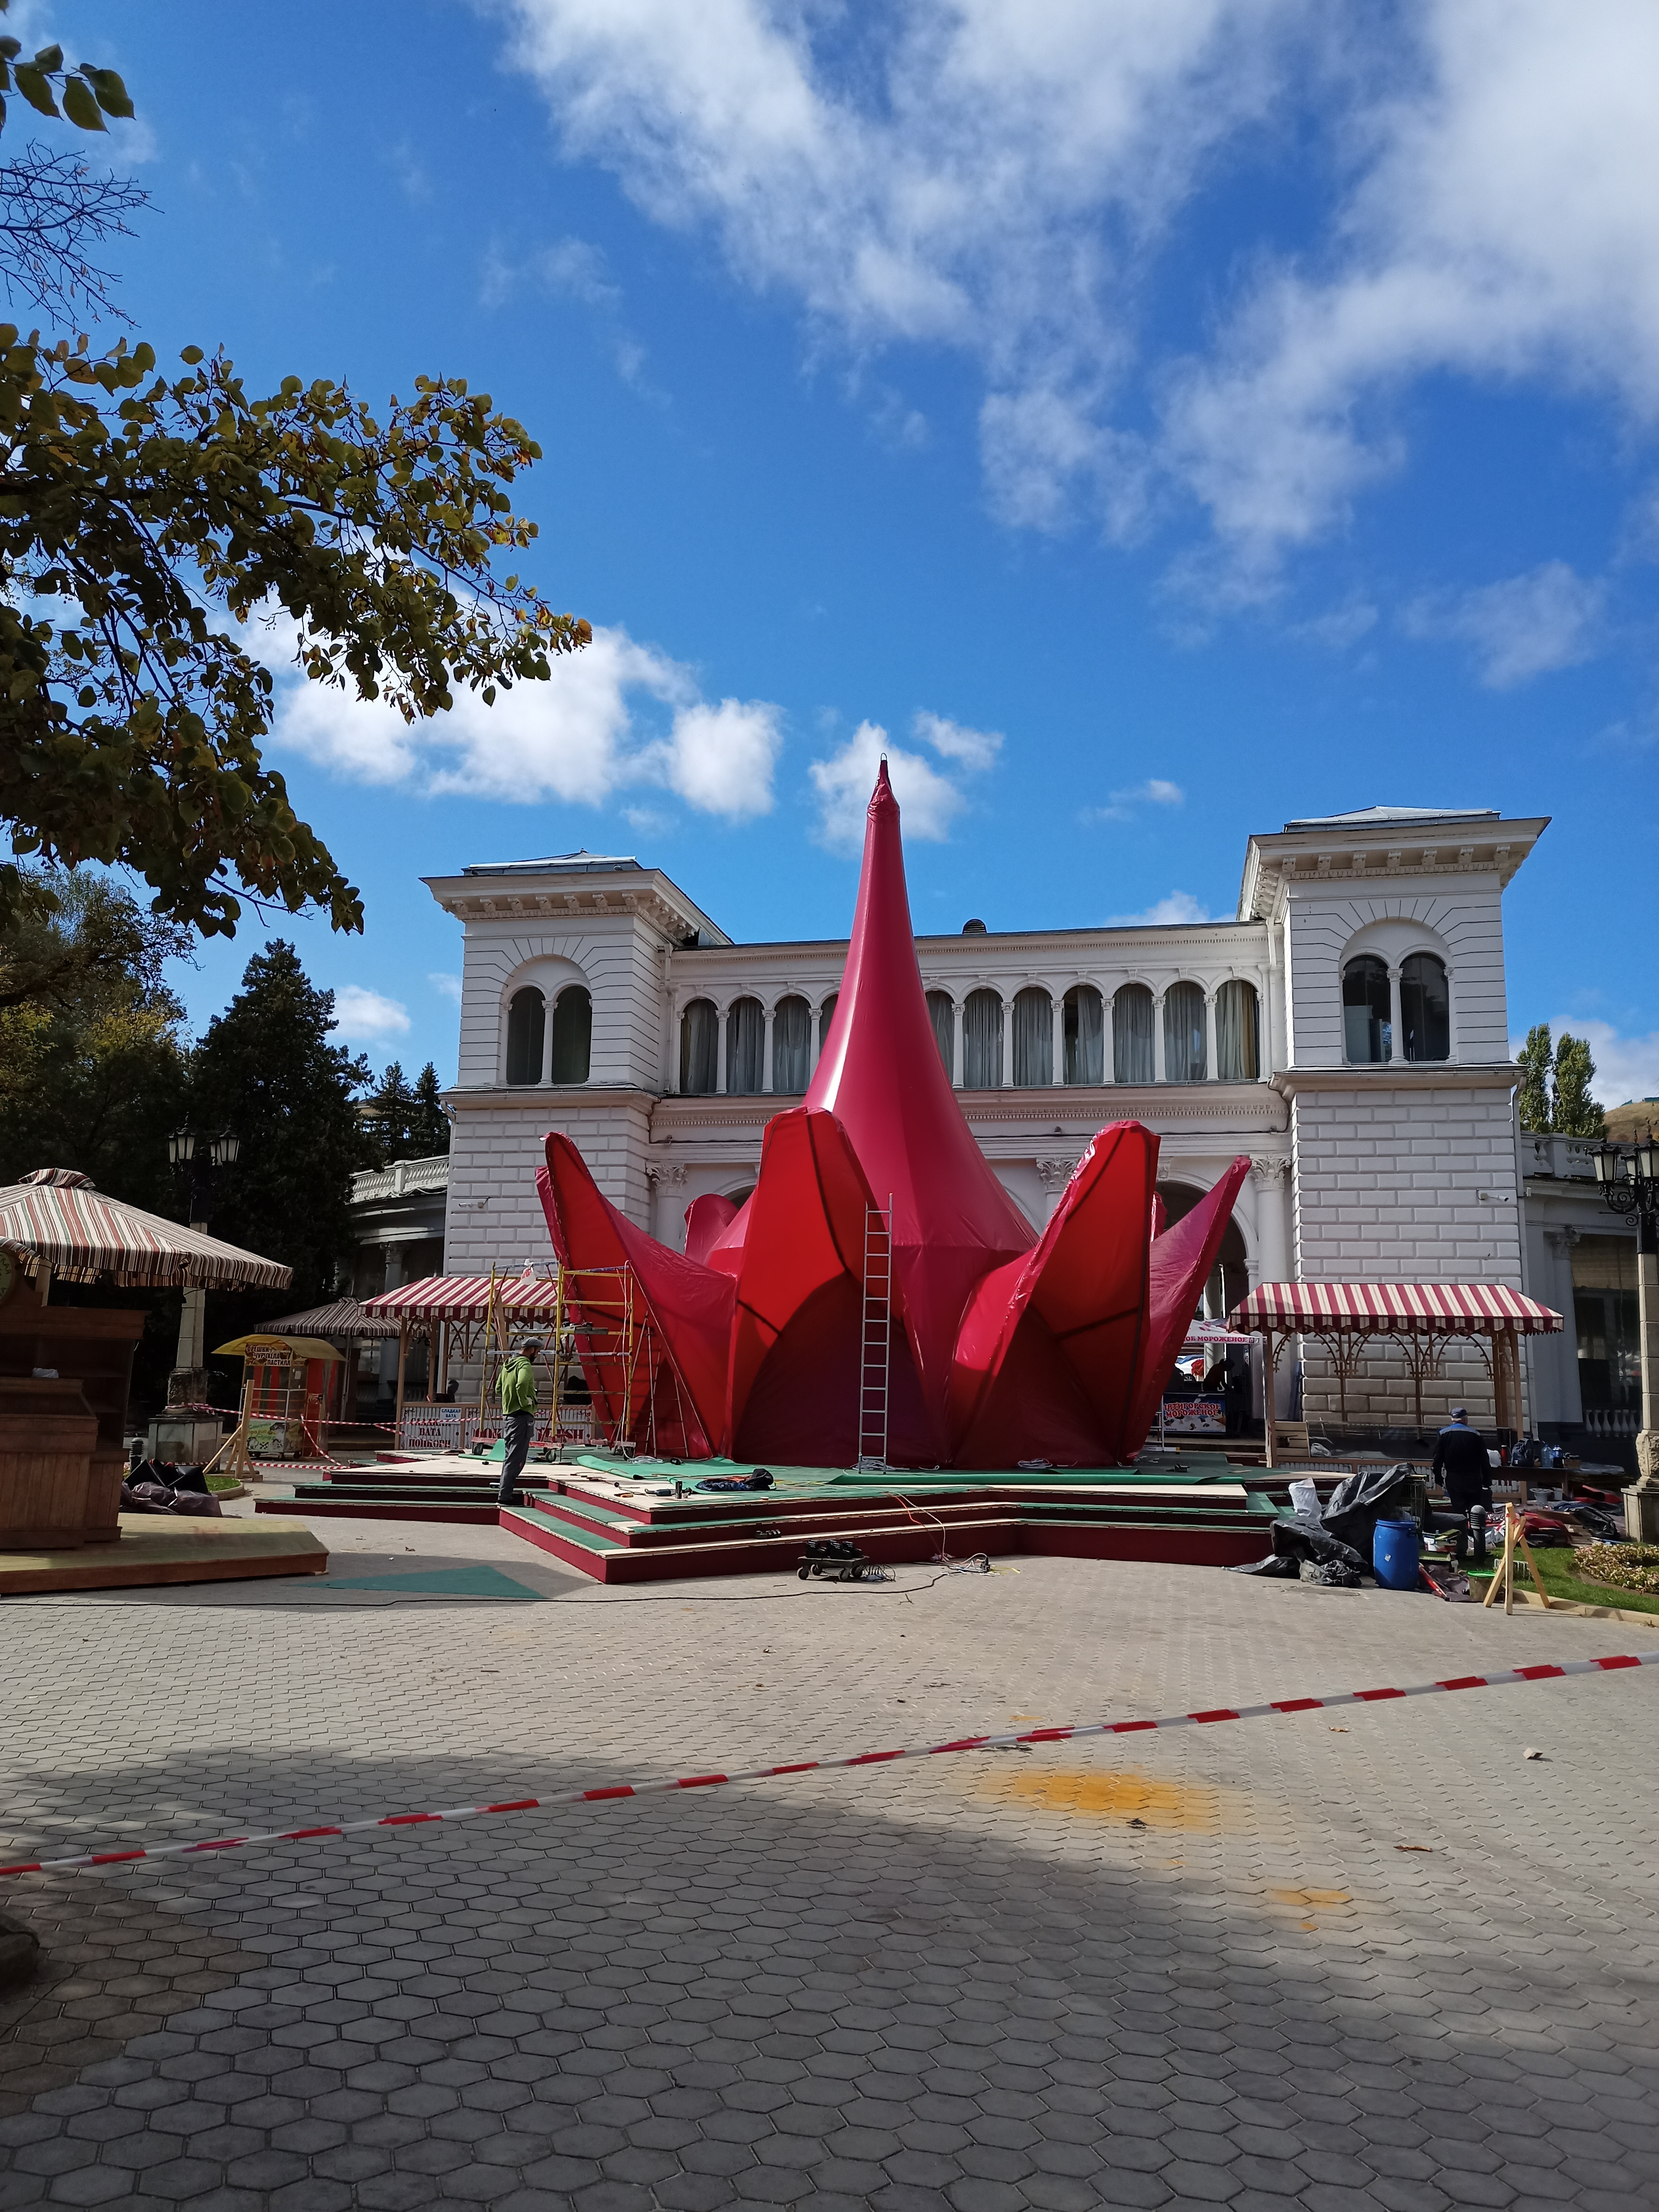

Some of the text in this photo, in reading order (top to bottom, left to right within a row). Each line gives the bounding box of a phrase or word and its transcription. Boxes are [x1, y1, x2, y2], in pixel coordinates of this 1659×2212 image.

[1166, 1409, 1218, 1418] МОРОЖЕНОЕ
[419, 1428, 441, 1436] ВАТА
[409, 1439, 451, 1448] ПОПКОРН
